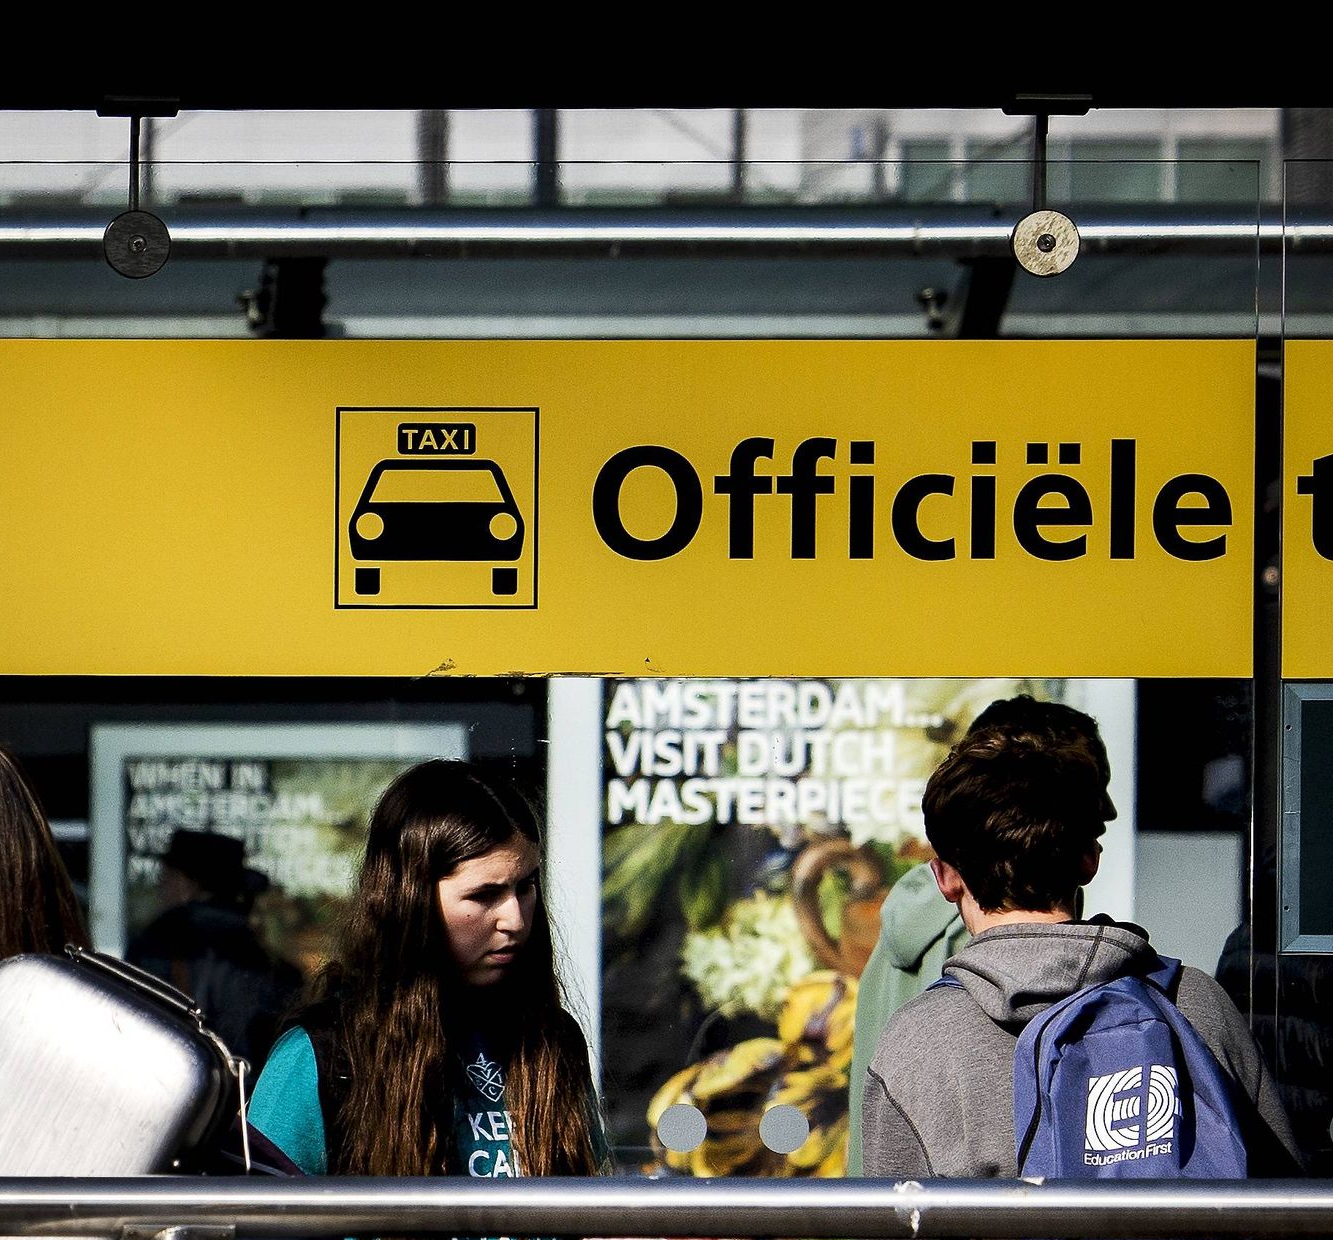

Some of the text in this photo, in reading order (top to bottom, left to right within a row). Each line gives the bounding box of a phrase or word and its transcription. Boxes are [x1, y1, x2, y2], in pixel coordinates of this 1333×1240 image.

[402, 429, 471, 450] TAXI
[591, 437, 1233, 561] Officiële
[606, 731, 895, 776] VISIT DUTCH
[1084, 1142, 1172, 1165] Education First
